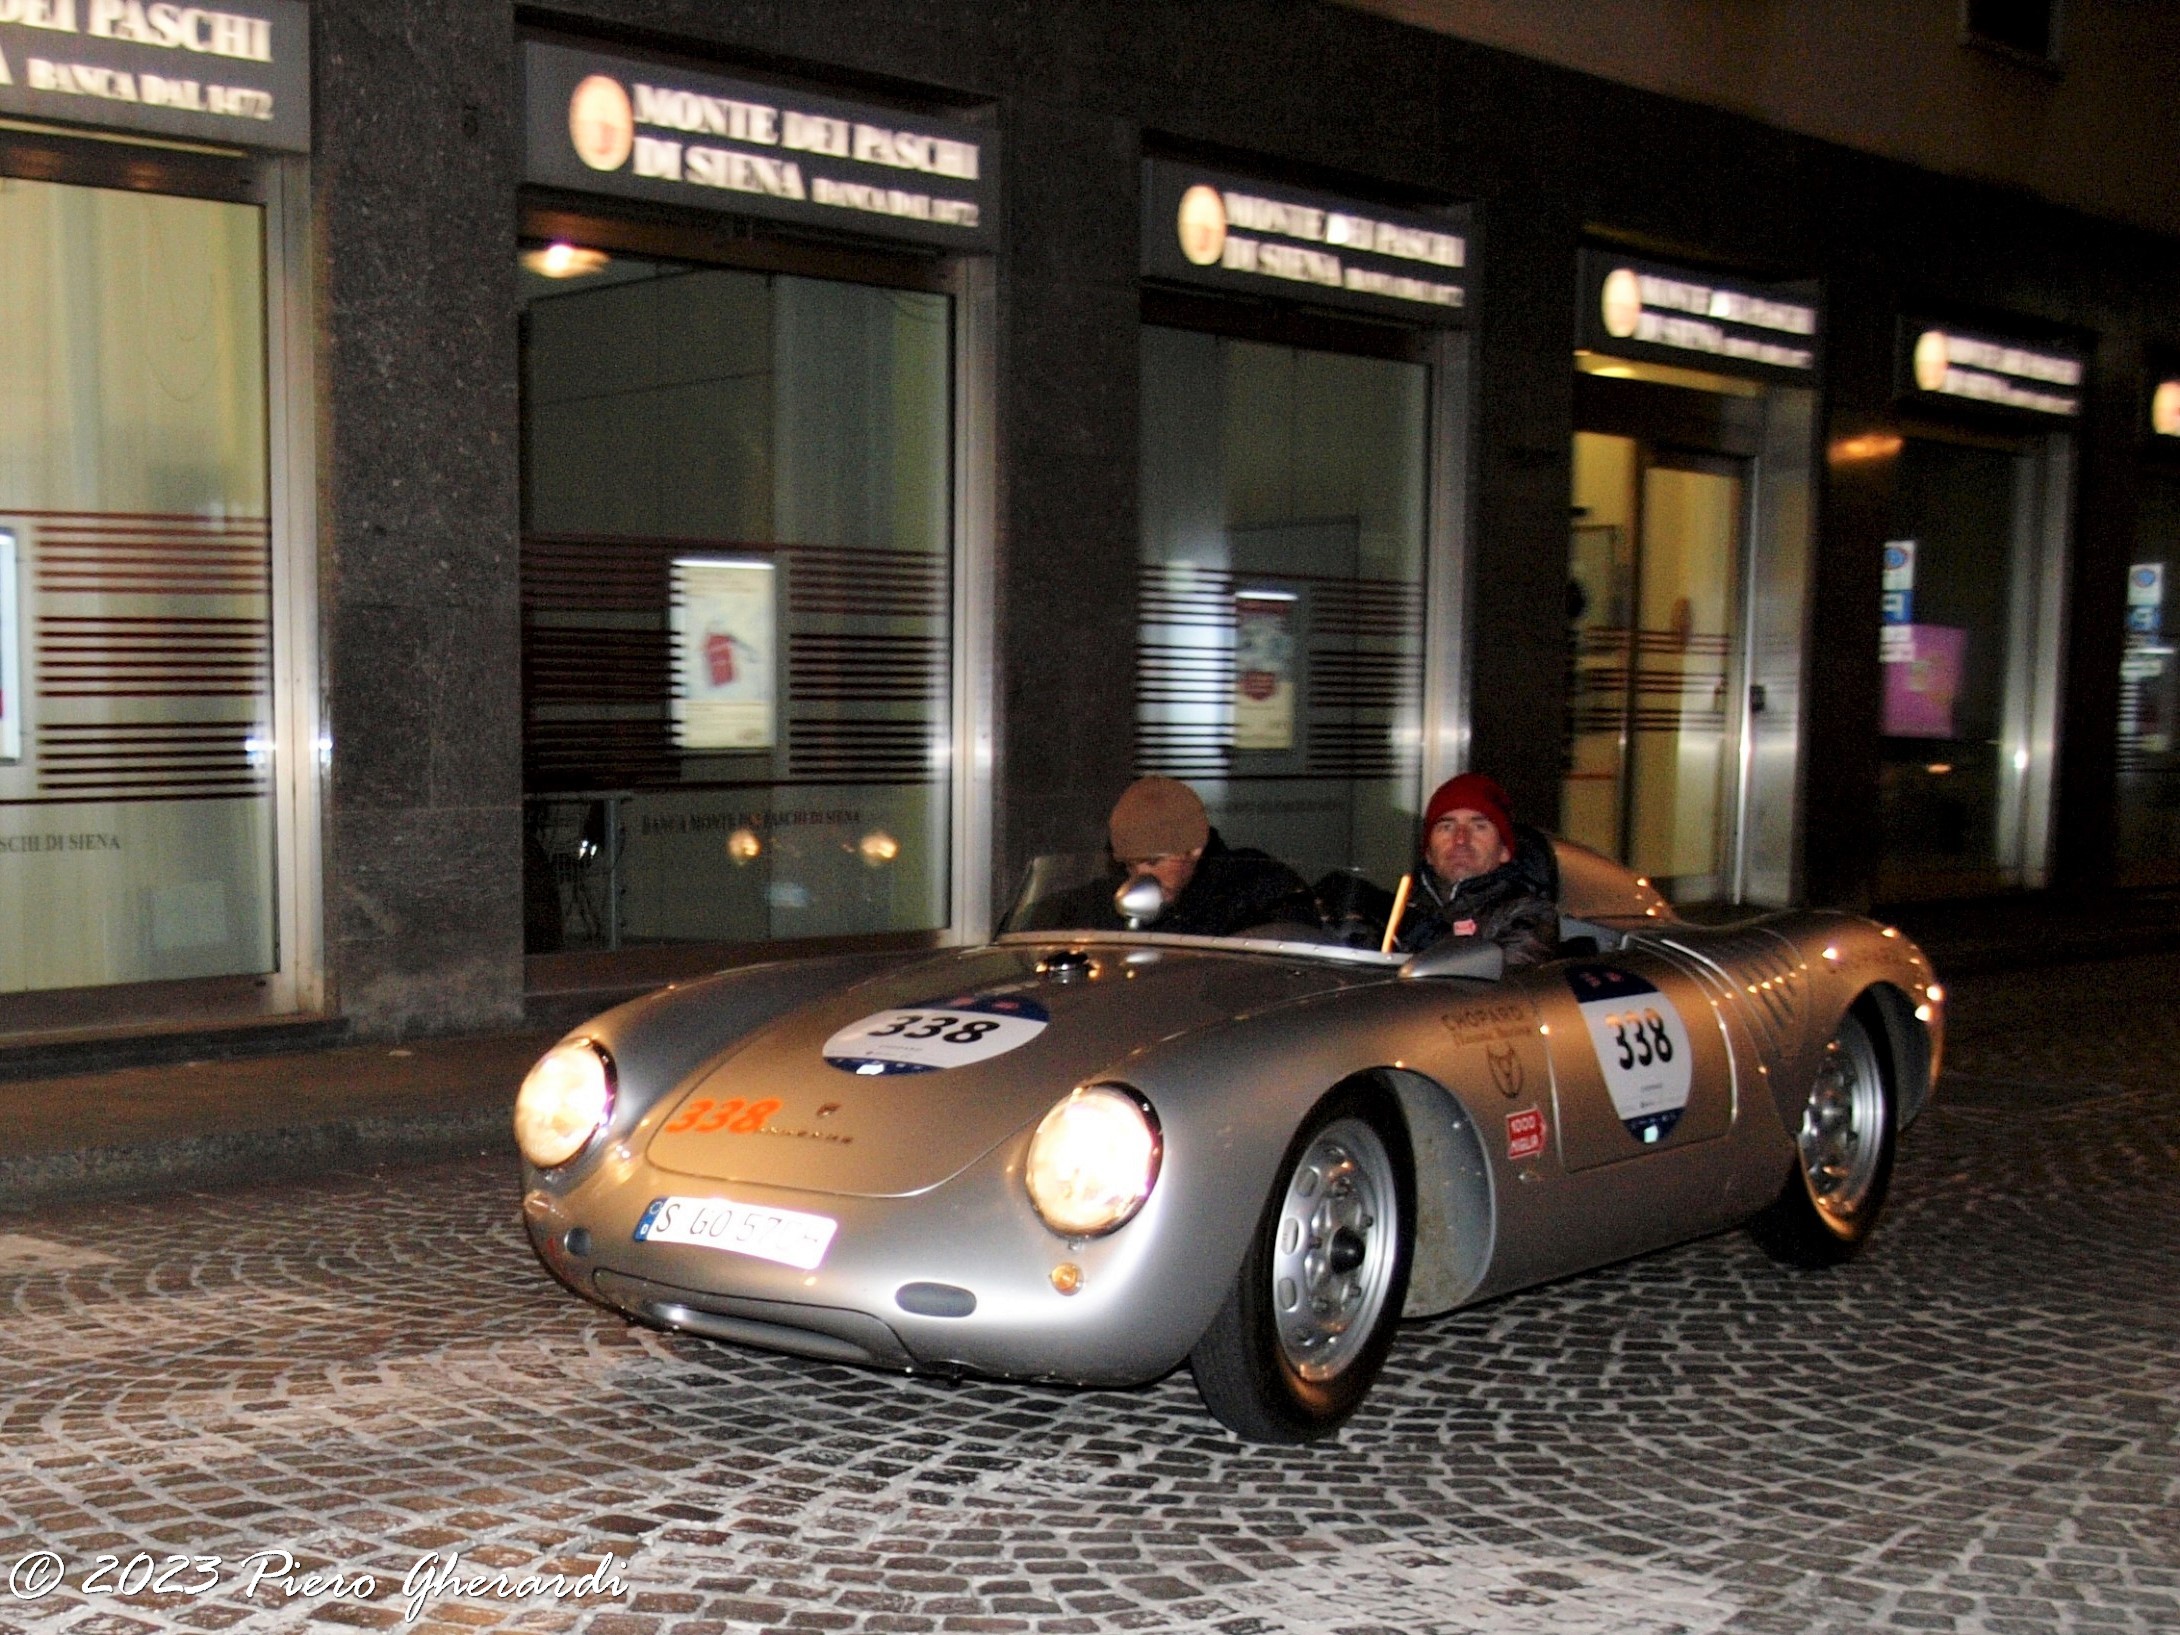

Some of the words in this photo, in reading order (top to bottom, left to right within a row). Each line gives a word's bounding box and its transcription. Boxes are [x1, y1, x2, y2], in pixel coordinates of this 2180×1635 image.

[88, 0, 273, 62] PASCHI
[632, 83, 780, 146] MONTE
[782, 110, 850, 158] DEI
[852, 123, 981, 180] PASCHI
[632, 136, 682, 181] DI
[685, 146, 806, 200] SIENA
[46, 835, 64, 851] DI
[68, 833, 121, 850] SIENA
[867, 1014, 1001, 1044] 338
[1606, 1008, 1673, 1070] 338
[664, 1097, 782, 1134] 338
[656, 1203, 681, 1233] S
[689, 1208, 733, 1238] GO
